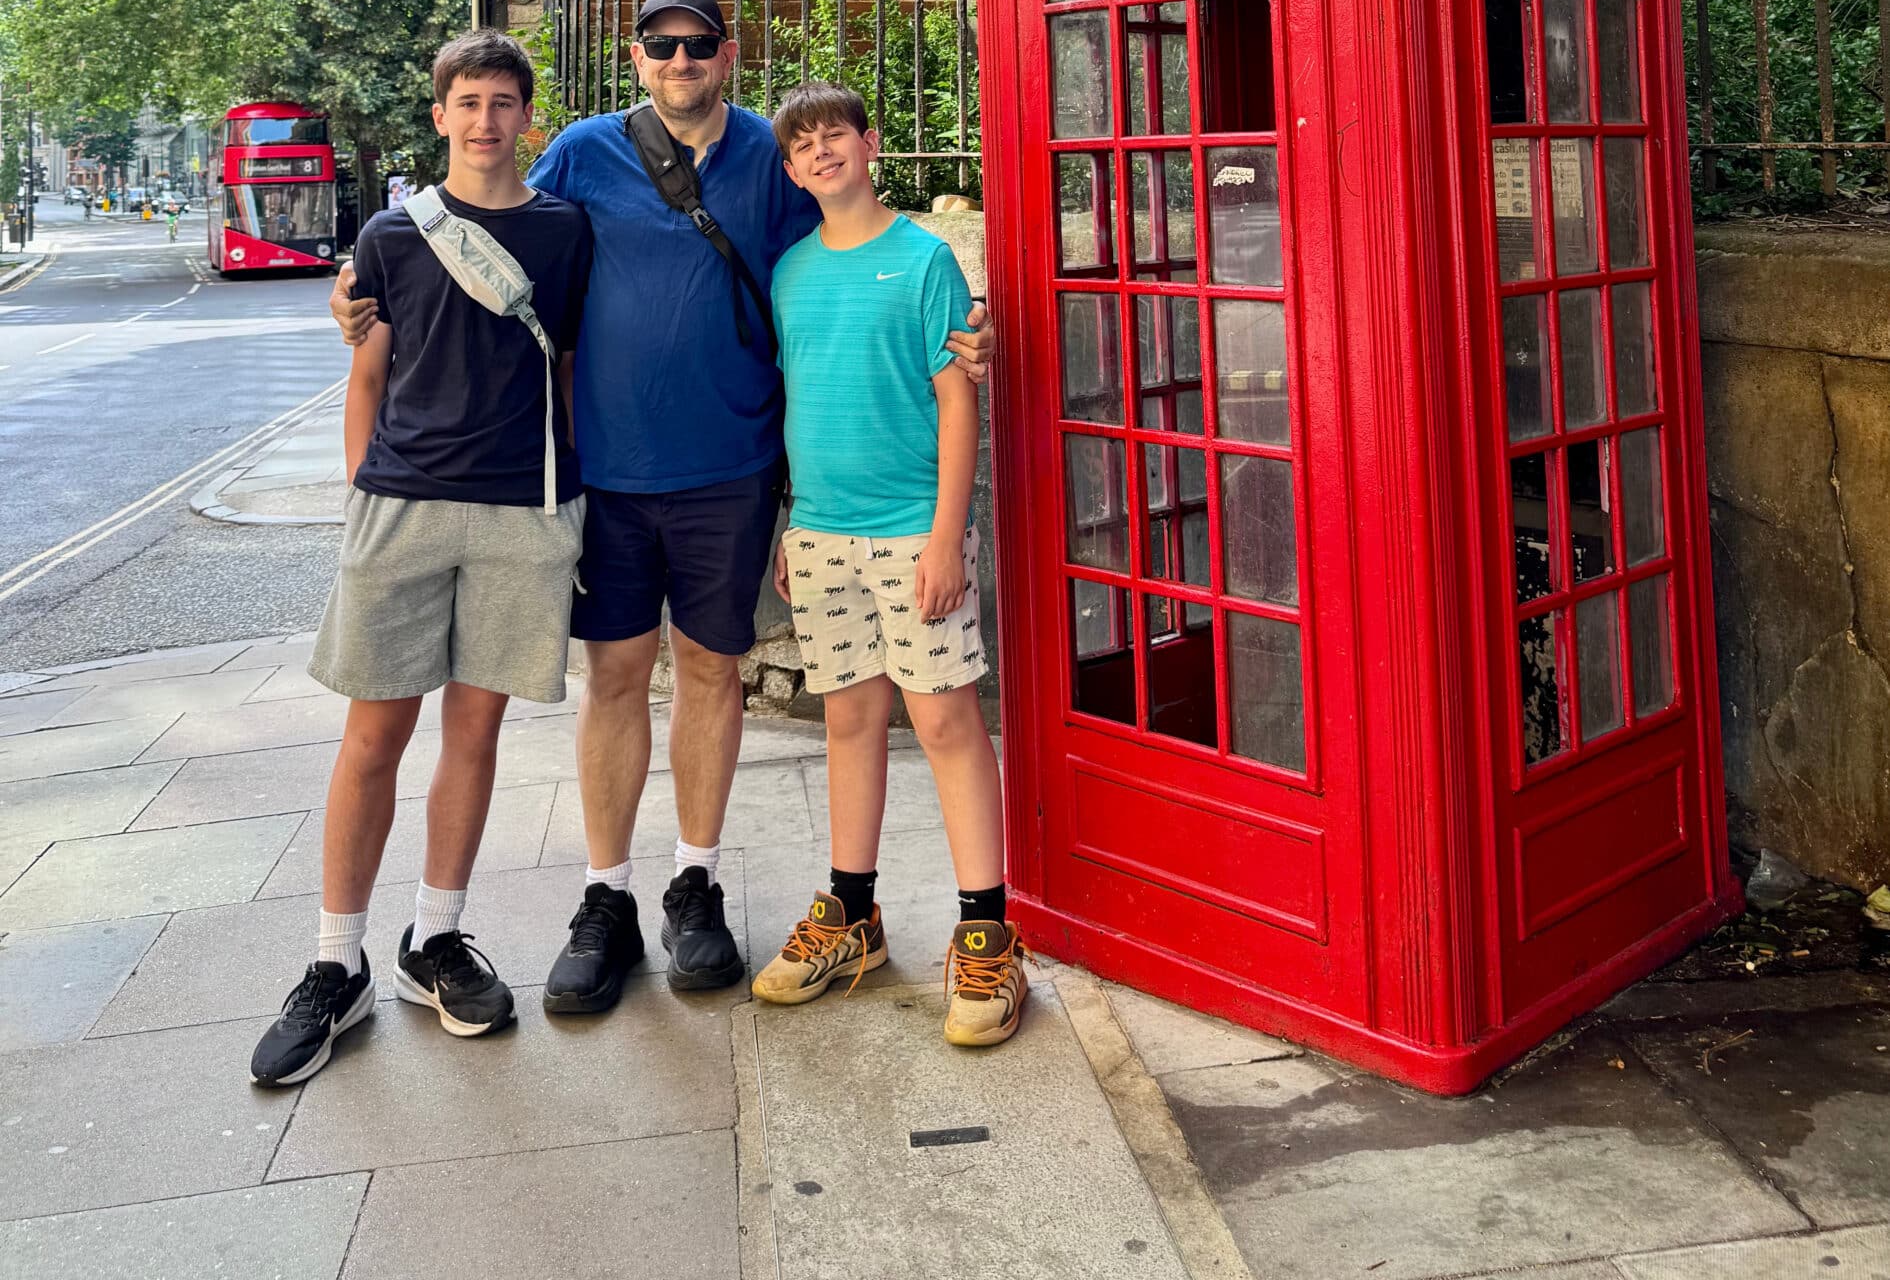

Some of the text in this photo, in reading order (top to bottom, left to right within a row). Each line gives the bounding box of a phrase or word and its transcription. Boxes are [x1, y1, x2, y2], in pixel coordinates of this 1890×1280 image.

[304, 160, 312, 172] 8
[873, 547, 893, 559] nike
[827, 606, 848, 618] nike
[832, 640, 852, 652] nike
[929, 644, 949, 658] nike
